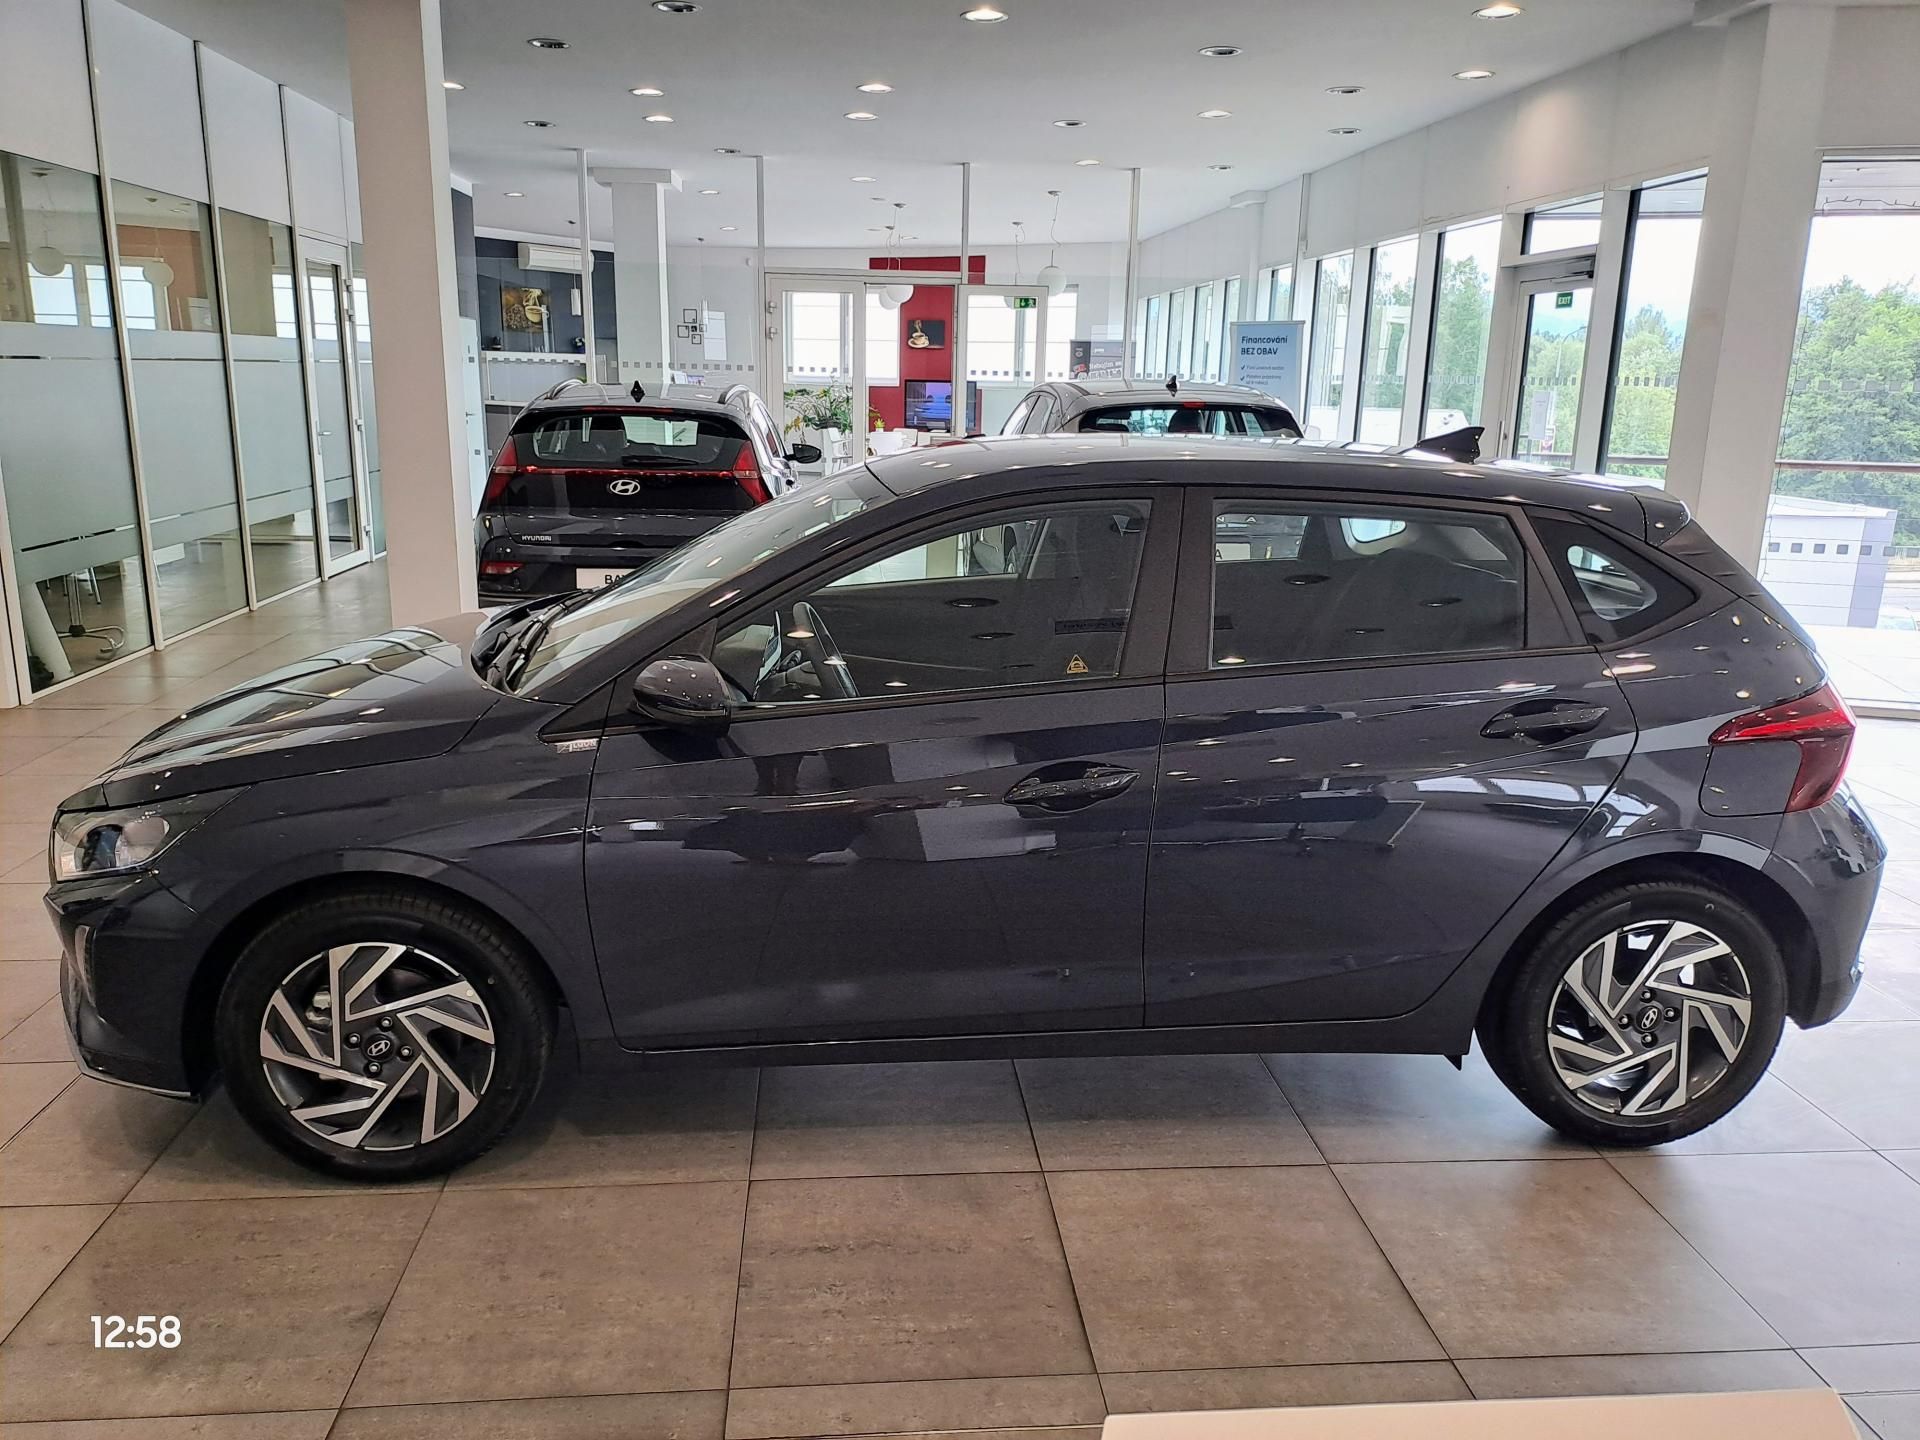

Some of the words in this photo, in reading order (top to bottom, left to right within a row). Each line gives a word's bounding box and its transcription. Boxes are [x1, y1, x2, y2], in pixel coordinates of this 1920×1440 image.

[1241, 335, 1288, 344] Financování
[1241, 347, 1256, 355] BEZ
[1256, 347, 1279, 355] OBAV
[604, 574, 626, 584] BA
